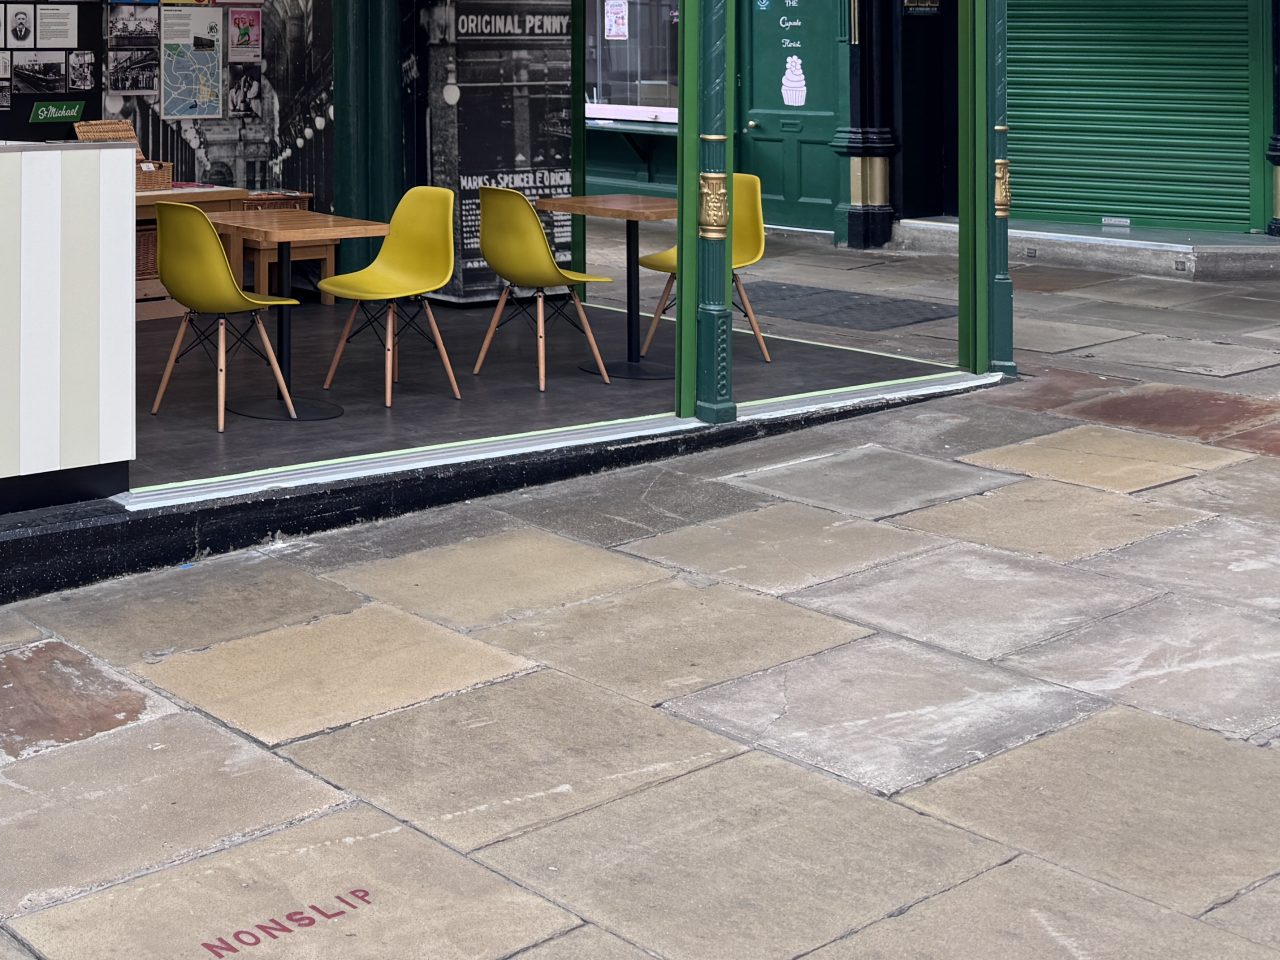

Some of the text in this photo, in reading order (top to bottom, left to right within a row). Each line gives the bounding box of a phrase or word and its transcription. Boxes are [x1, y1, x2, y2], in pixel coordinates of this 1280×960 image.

[458, 14, 569, 34] ORIGINAL PENNY
[48, 105, 79, 118] Michael
[460, 175, 489, 190] MARKS
[497, 171, 535, 188] SPENCER
[200, 889, 372, 959] NONSLIP
